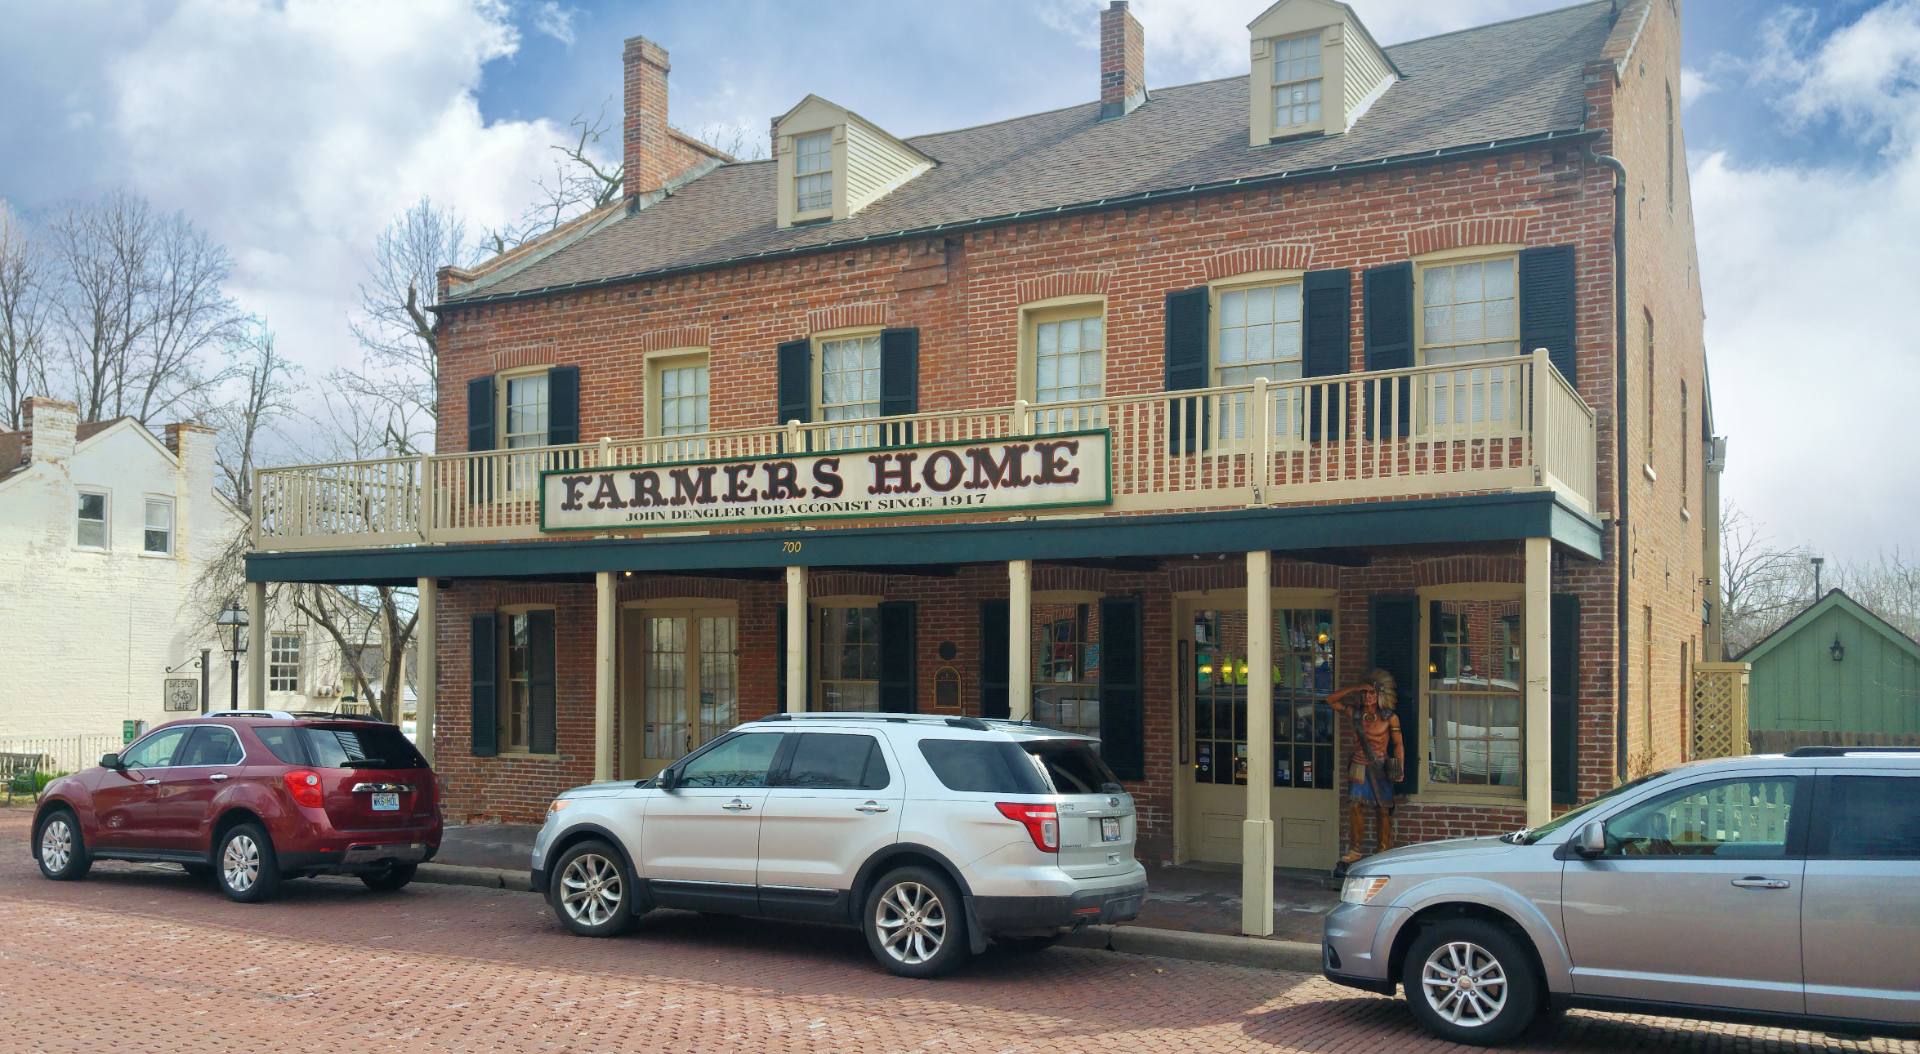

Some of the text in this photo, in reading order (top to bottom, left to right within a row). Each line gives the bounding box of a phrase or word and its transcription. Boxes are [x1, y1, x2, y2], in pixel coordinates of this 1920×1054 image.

[560, 440, 1080, 511] FARMERS HOME
[625, 493, 987, 522] JOHN DENGLER TOBACCONIST SINCE 1917
[782, 541, 801, 553] 700
